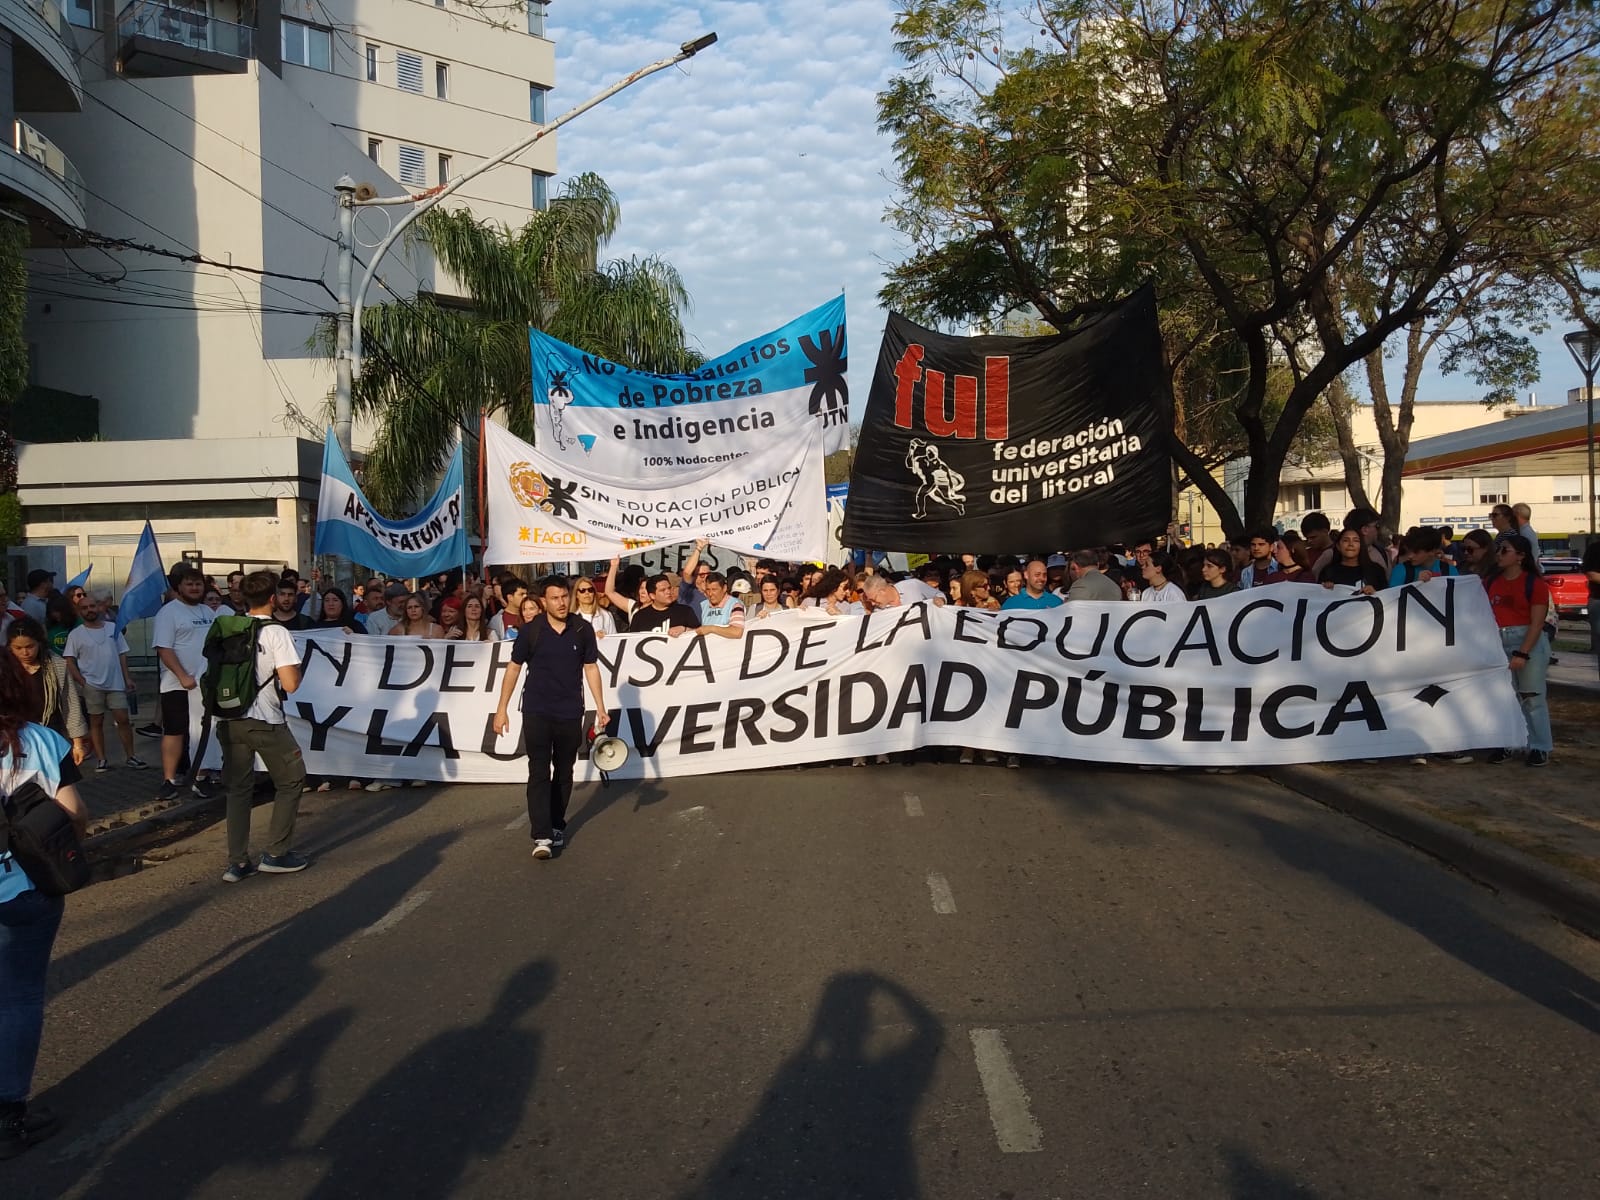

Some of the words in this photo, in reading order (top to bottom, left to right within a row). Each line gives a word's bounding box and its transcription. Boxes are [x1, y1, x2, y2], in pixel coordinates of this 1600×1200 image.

[582, 354, 616, 376] No
[618, 385, 645, 408] de
[652, 377, 763, 406] Pobreza
[894, 343, 1010, 440] ful
[613, 425, 626, 440] e
[632, 408, 775, 444] Indigencia
[992, 416, 1124, 461] federación
[642, 457, 674, 467] 100%
[991, 434, 1142, 483] universitaria
[580, 485, 610, 503] SIN
[989, 485, 1028, 504] del
[1041, 466, 1115, 500] litoral
[621, 513, 649, 528] NO
[655, 515, 693, 529] HAY
[699, 497, 771, 526] FUTURO
[737, 518, 772, 533] REGIONAL
[298, 638, 353, 687] N
[739, 621, 838, 681] DE
[854, 600, 931, 655] LA
[295, 701, 353, 751] Y
[365, 708, 461, 760] LA
[1004, 669, 1388, 742] PÚBLICA
